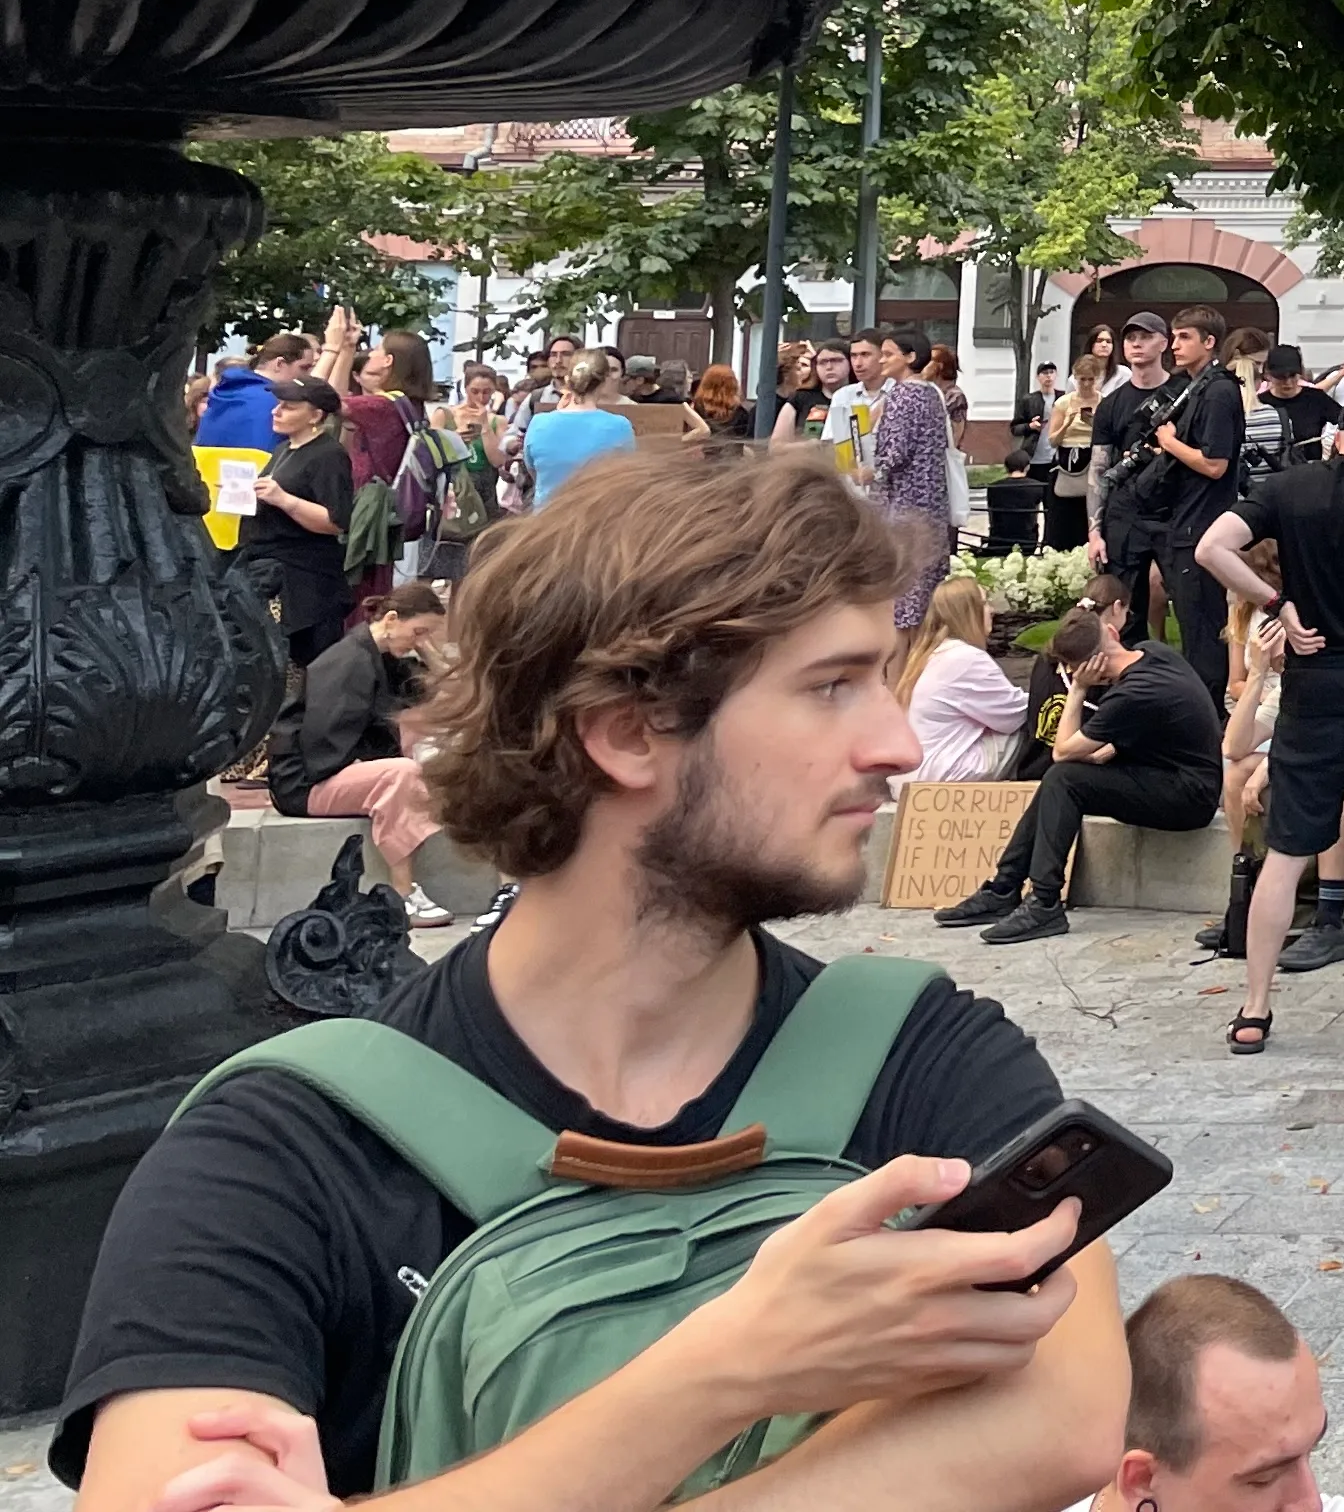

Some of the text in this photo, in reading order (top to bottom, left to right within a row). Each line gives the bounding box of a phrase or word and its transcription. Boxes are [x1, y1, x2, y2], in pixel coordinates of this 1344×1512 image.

[912, 787, 1034, 814] CORRUPT
[908, 817, 926, 841] IS
[938, 818, 986, 842] ONLY
[902, 845, 924, 869] IF
[933, 845, 967, 869] I'M
